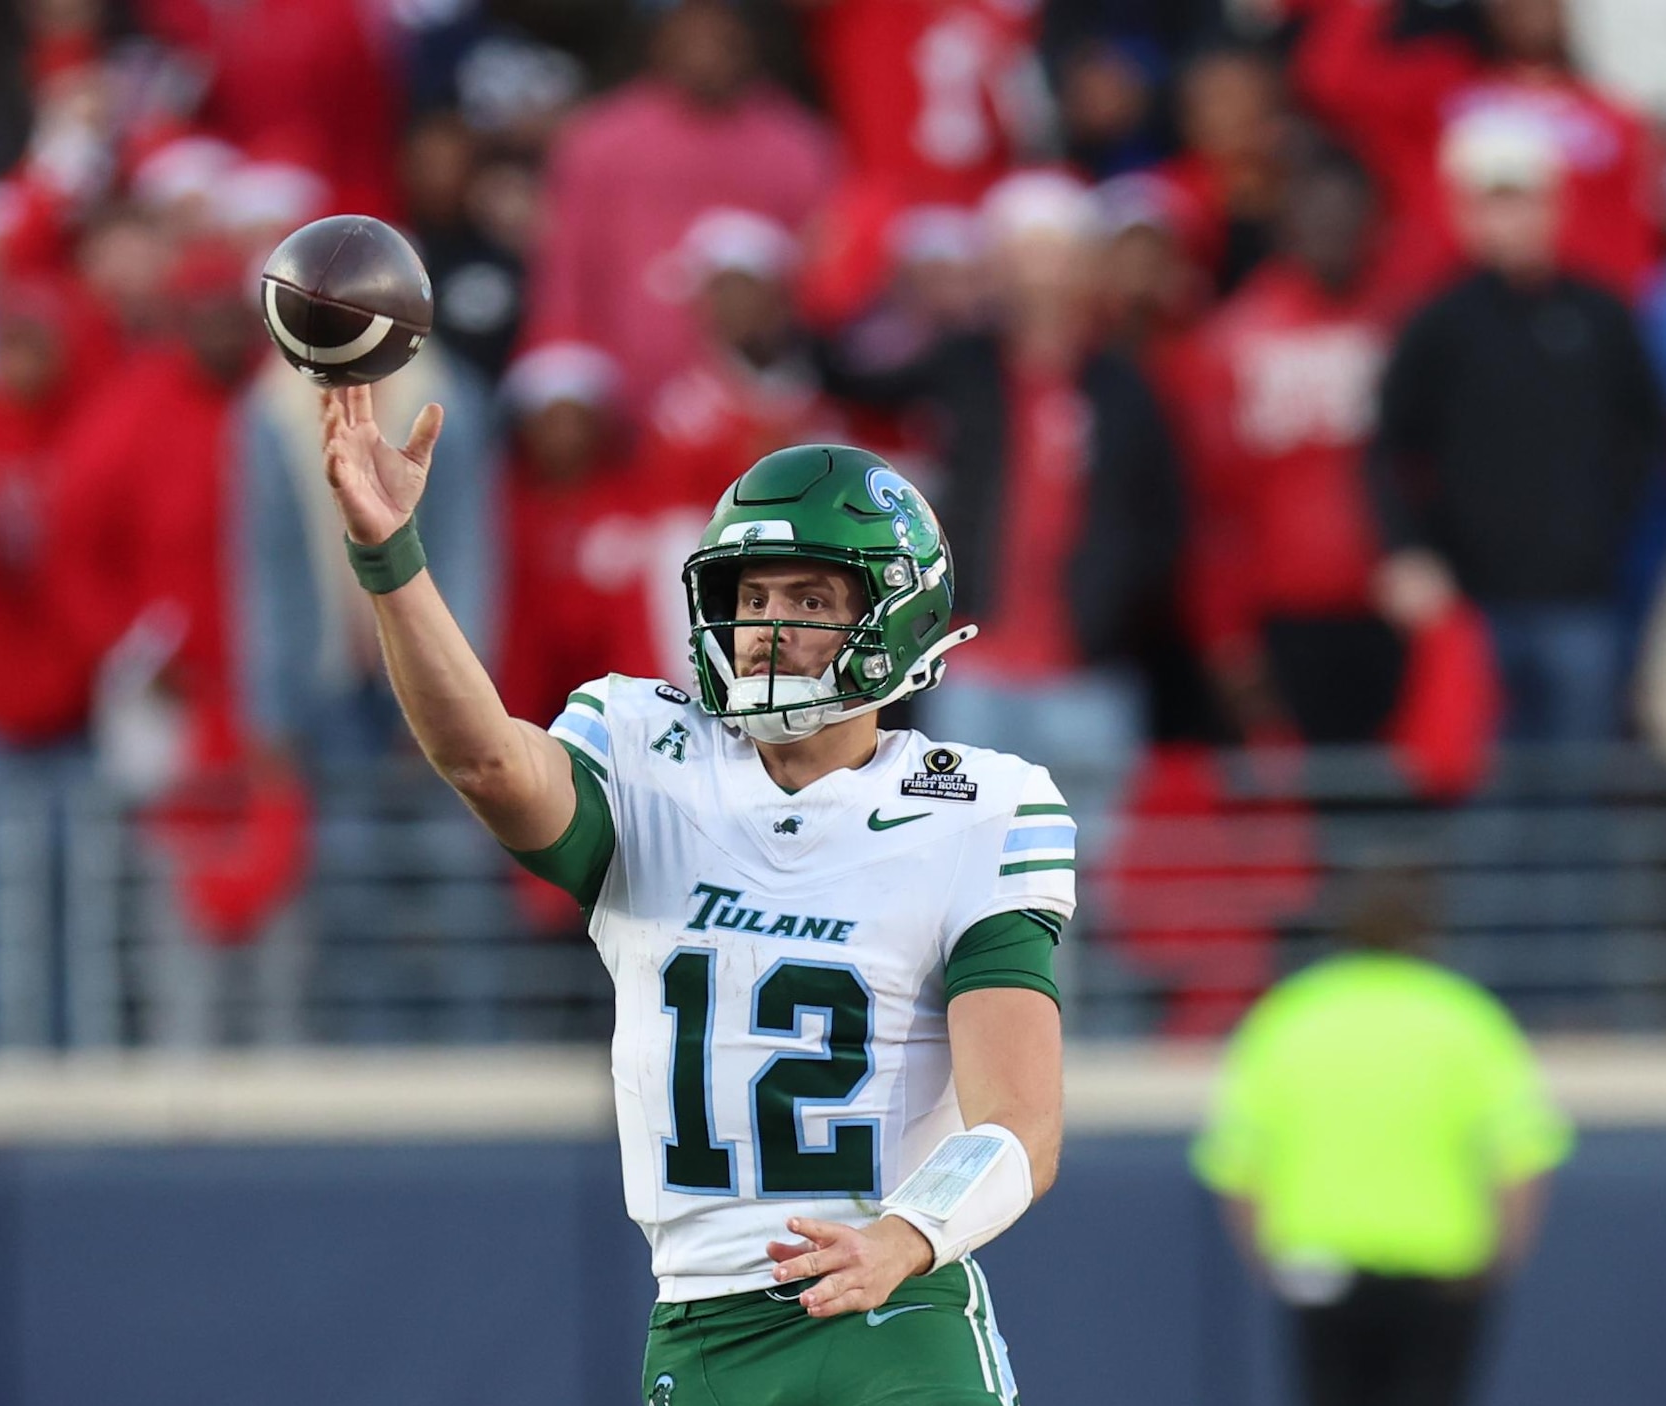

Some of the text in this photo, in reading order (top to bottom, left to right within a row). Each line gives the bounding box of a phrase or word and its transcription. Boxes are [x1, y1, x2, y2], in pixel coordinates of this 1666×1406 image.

[903, 780, 975, 793] FIRST ROUND
[916, 773, 964, 782] PLAYOFF
[685, 881, 858, 943] TULANE
[659, 945, 882, 1200] 12
